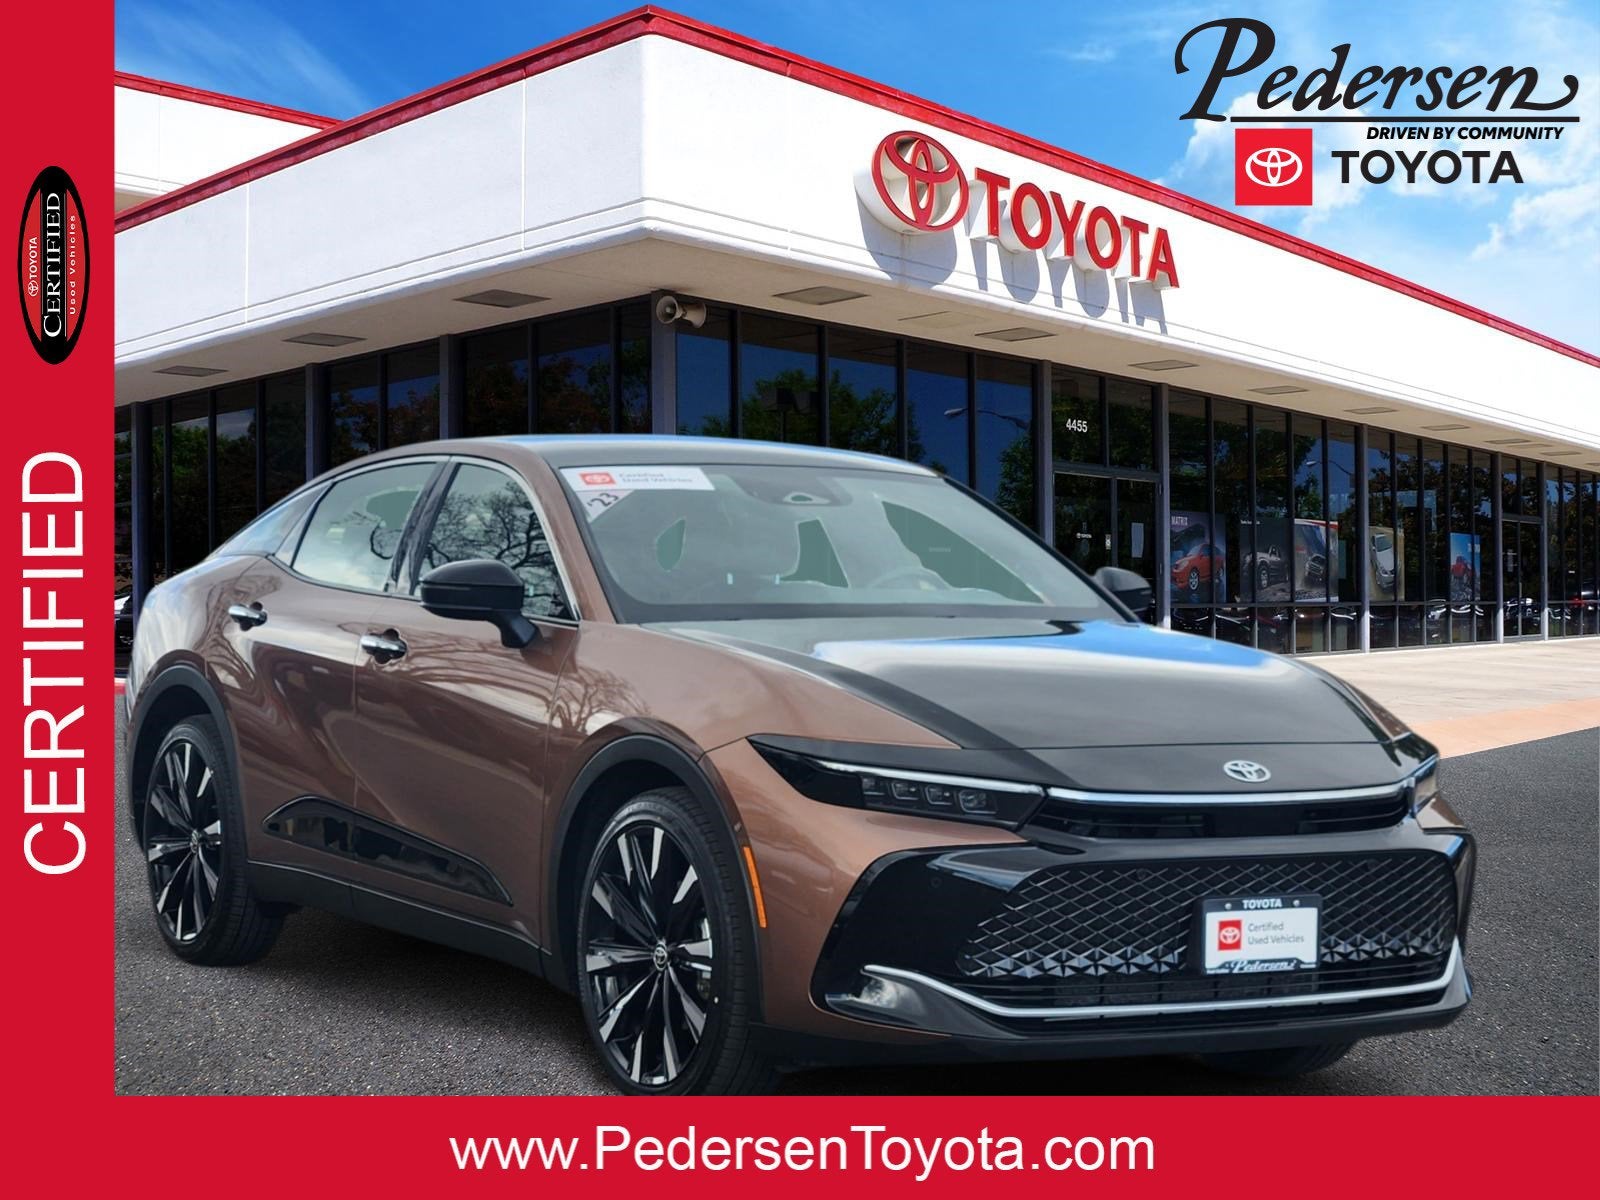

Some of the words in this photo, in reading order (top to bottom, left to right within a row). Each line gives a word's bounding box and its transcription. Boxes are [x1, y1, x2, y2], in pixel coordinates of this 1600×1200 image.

[973, 167, 1180, 289] TOYOTA
[1065, 418, 1088, 433] 4455
[1242, 898, 1282, 909] TOYOTA
[1248, 921, 1284, 932] Certified
[1248, 936, 1269, 945] Used
[1271, 933, 1304, 944] Vehicles
